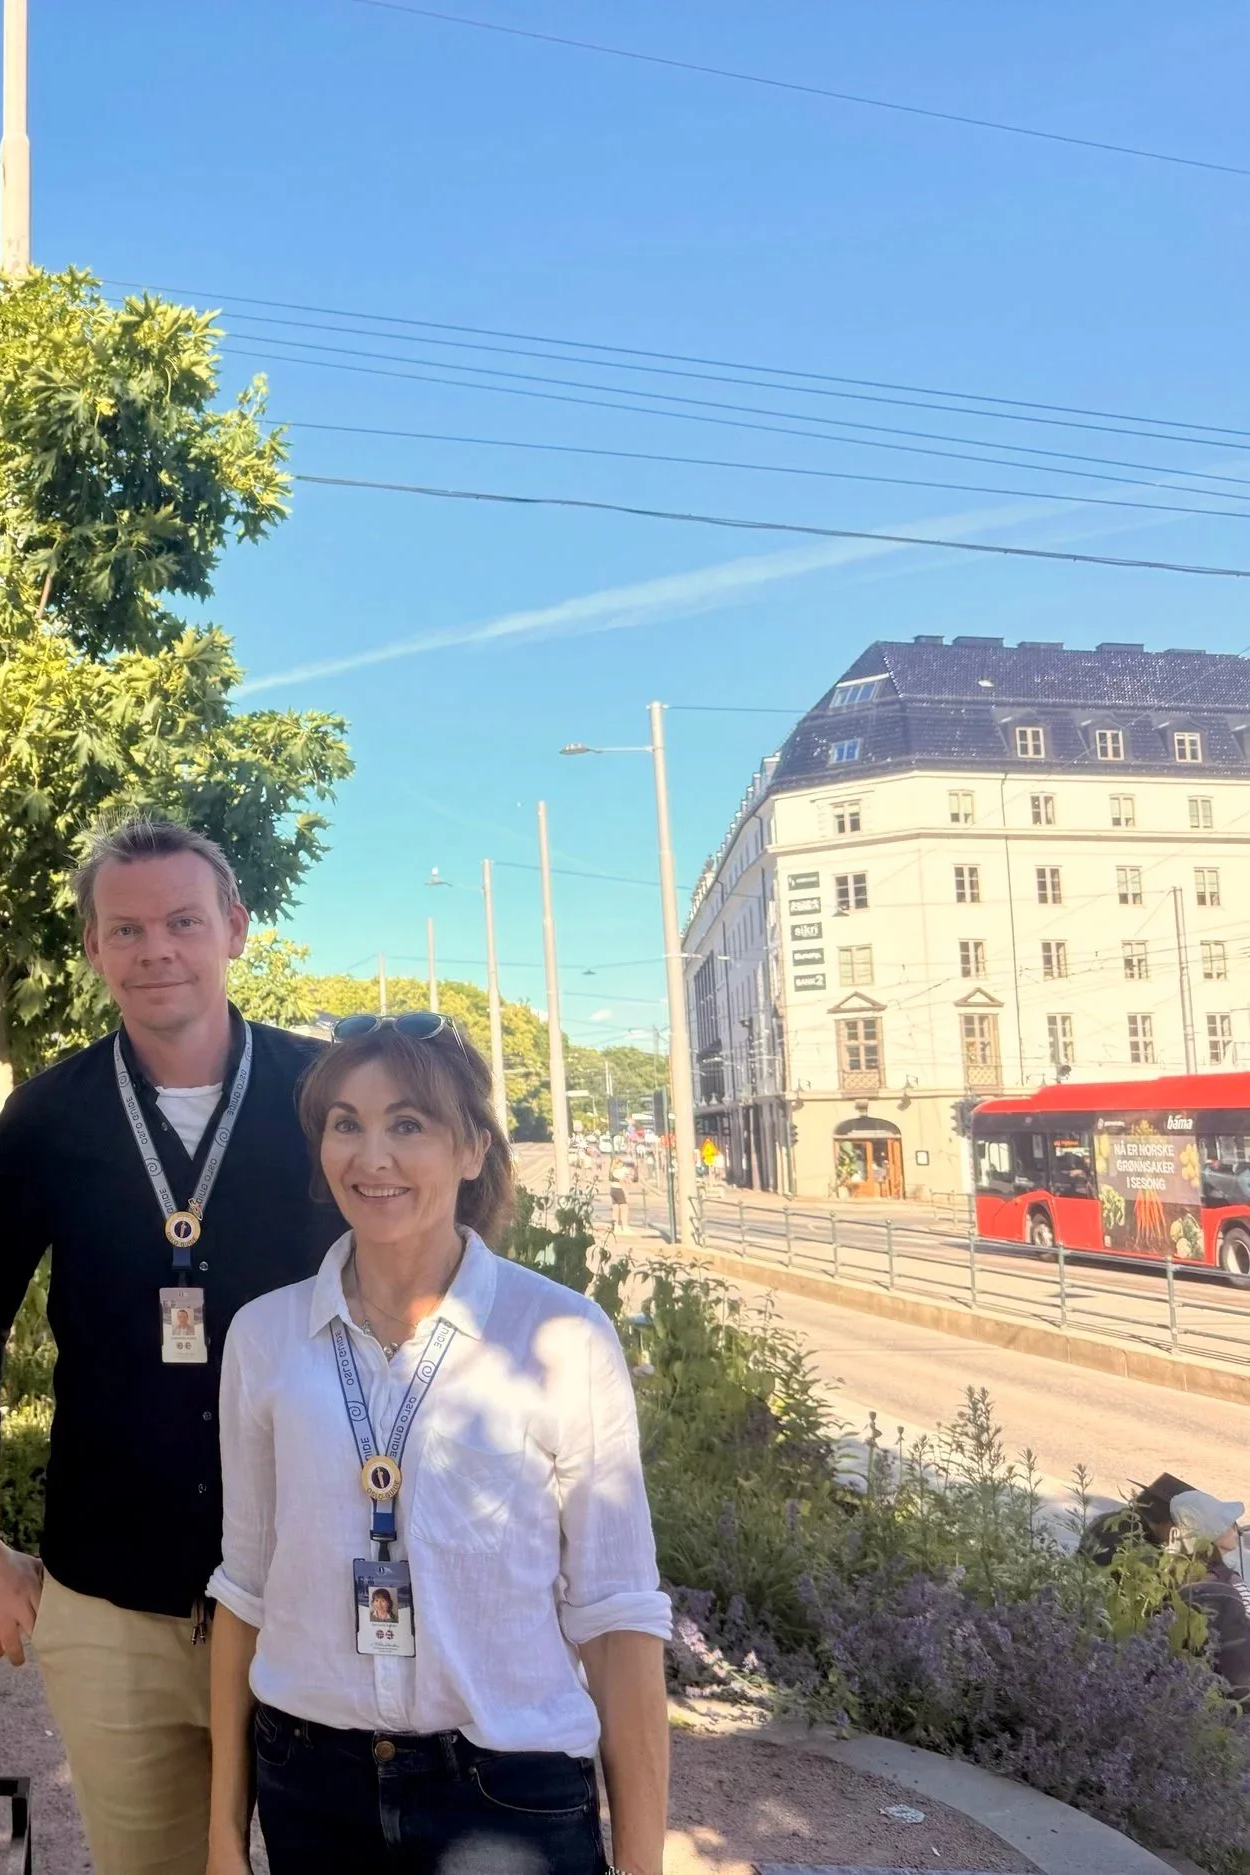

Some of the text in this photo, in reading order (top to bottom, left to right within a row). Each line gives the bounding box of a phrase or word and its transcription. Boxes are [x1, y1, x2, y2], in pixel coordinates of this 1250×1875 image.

[1113, 1140, 1175, 1157] NÅ ER NORSKE
[1116, 1159, 1175, 1174] GRØNNSAKER
[1131, 1176, 1166, 1190] SESONG
